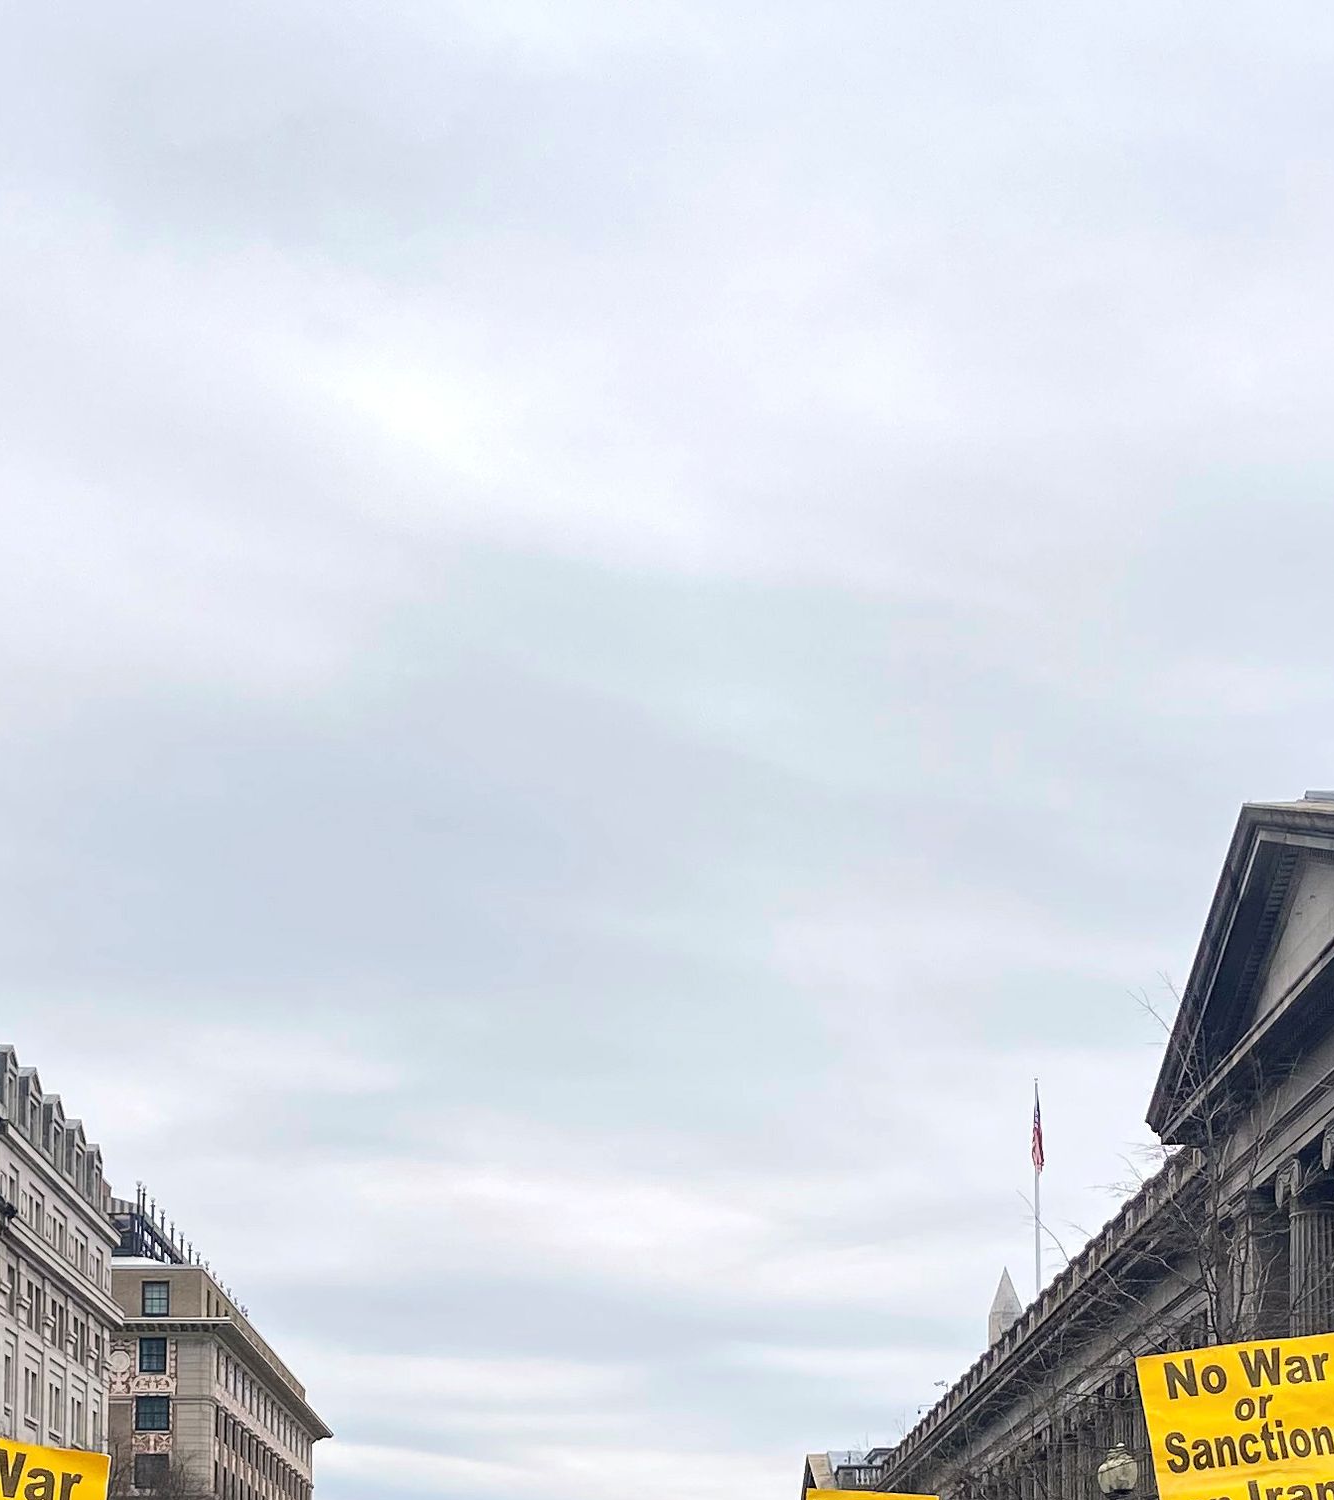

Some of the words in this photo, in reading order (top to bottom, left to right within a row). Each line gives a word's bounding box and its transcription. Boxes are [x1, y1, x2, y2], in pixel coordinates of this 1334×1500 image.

[1164, 1359, 1227, 1400] No
[1239, 1347, 1328, 1387] War
[1235, 1394, 1273, 1421] or
